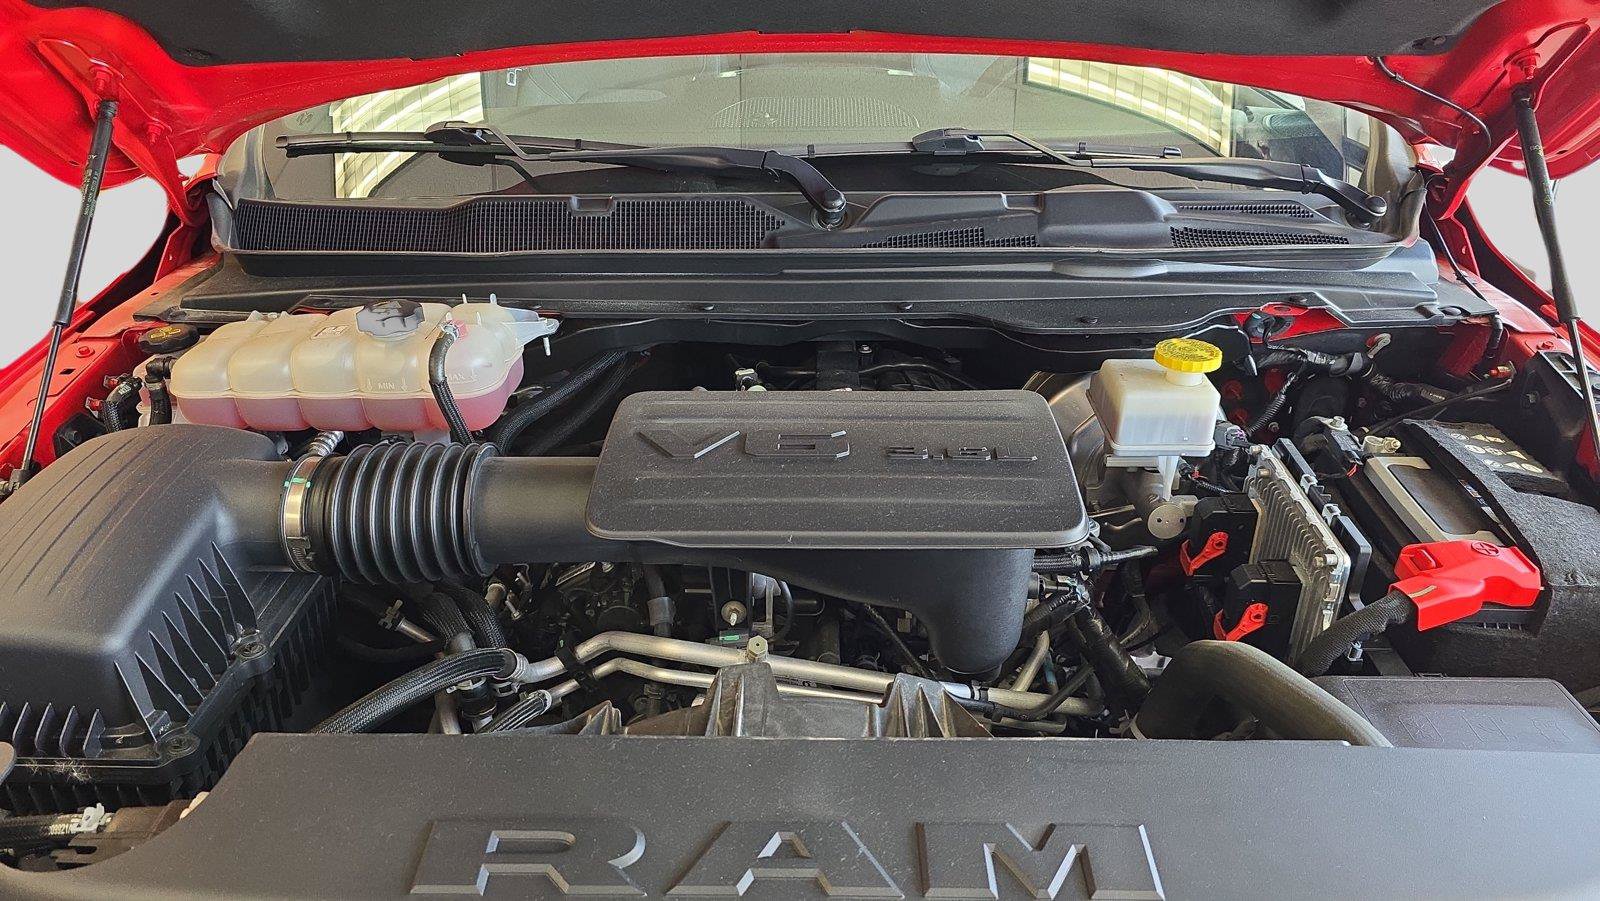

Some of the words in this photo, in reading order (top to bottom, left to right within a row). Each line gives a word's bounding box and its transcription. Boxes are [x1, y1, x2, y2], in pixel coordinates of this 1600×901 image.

[377, 382, 395, 390] MIN
[636, 429, 851, 459] V6
[409, 820, 1166, 901] RAM
